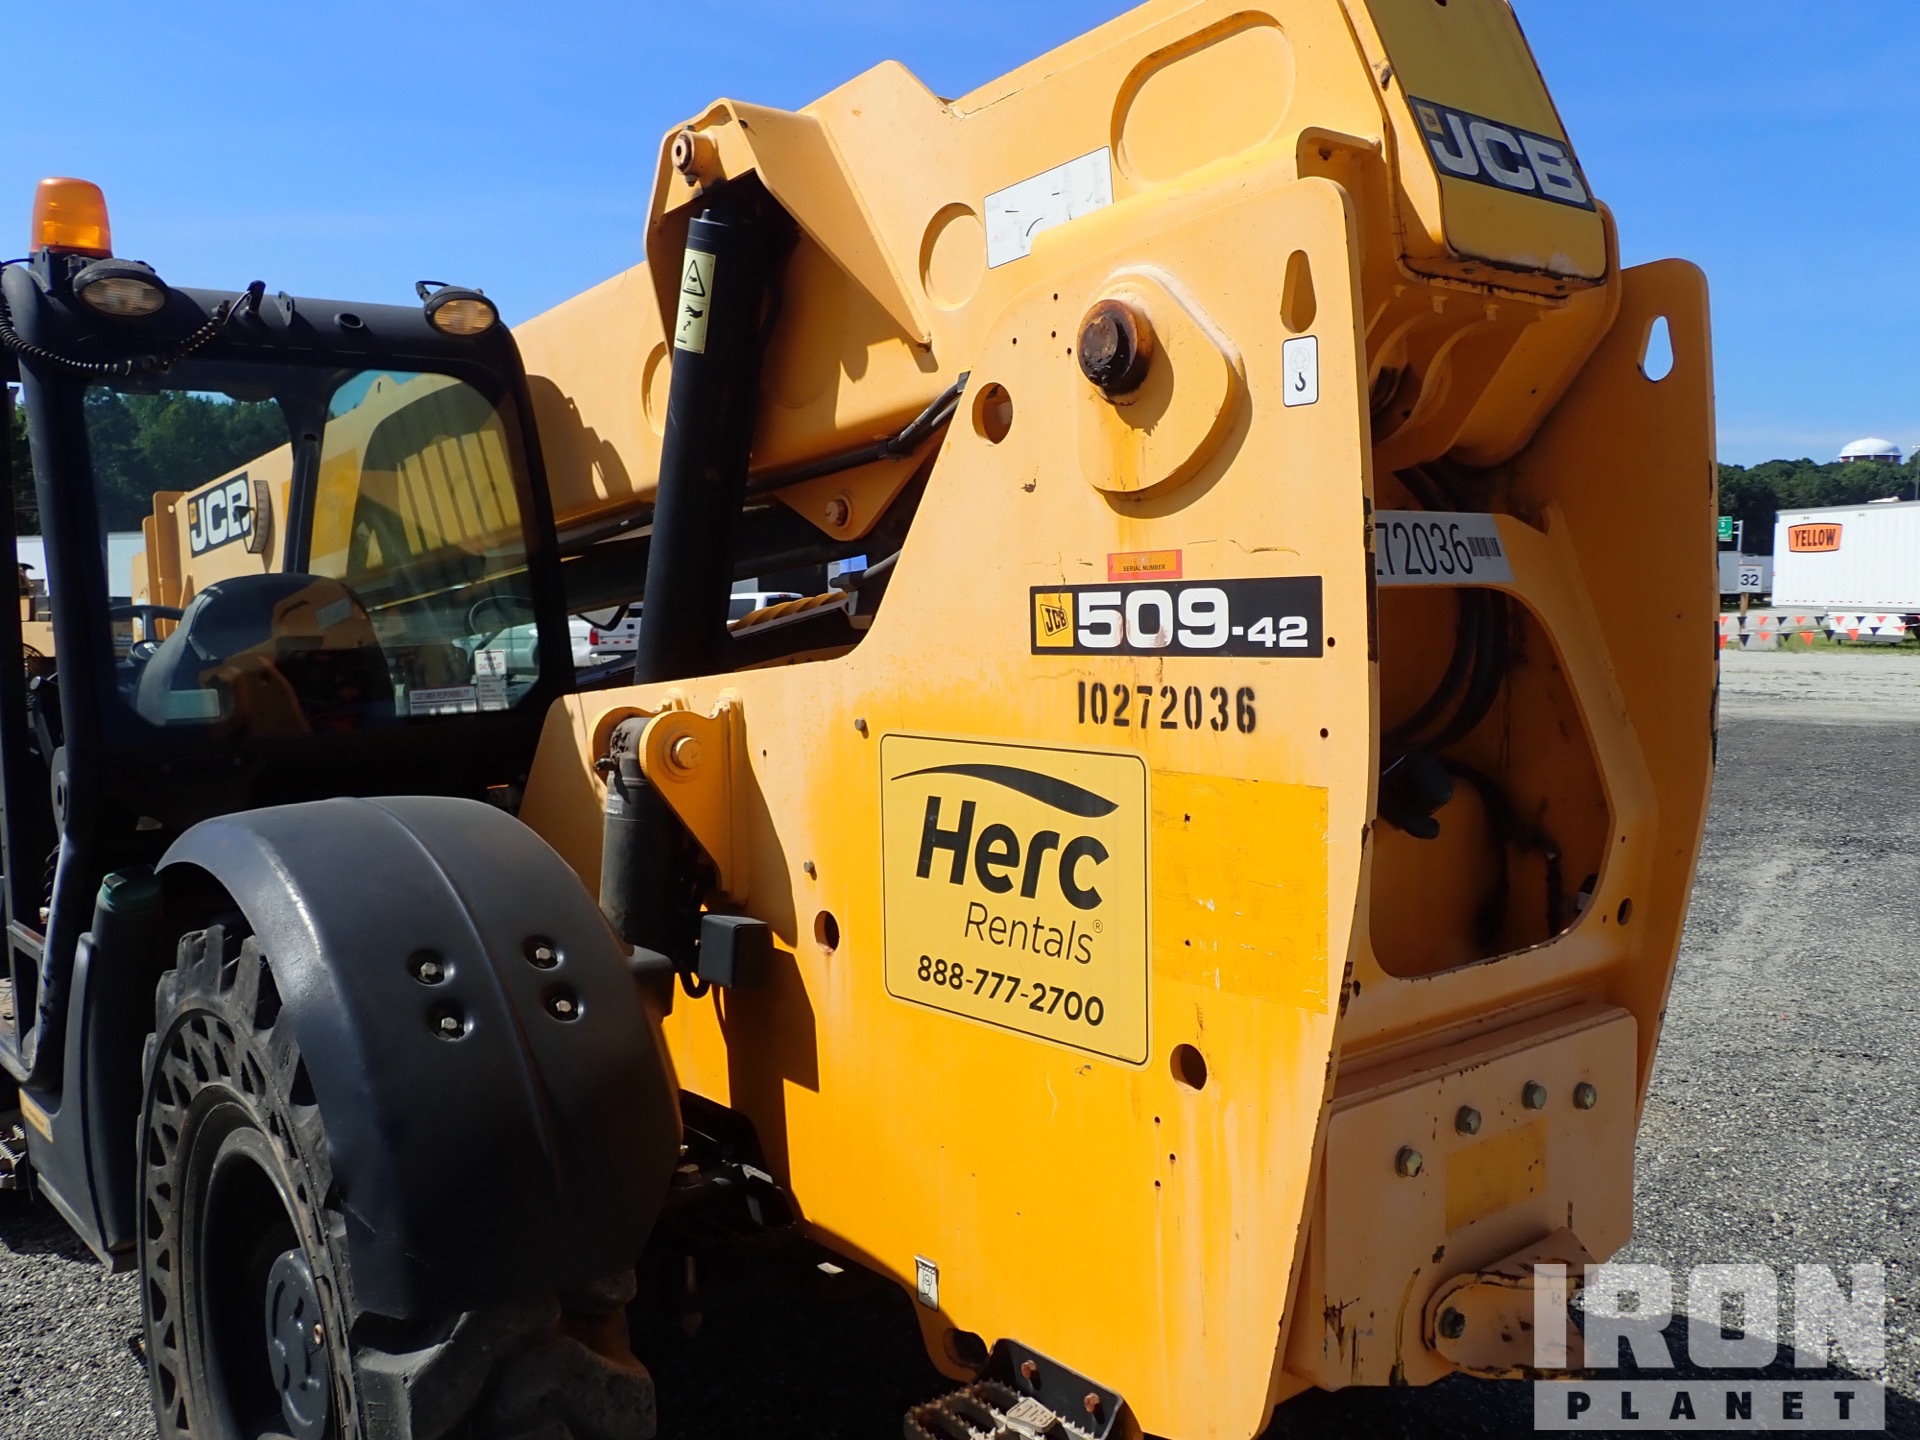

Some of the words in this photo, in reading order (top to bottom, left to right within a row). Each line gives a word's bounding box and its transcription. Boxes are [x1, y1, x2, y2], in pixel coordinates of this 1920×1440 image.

[1430, 113, 1587, 204] JCB
[191, 479, 250, 551] JCB
[1794, 528, 1837, 547] YELLOW
[1376, 522, 1474, 575] 72036
[1740, 573, 1759, 586] 32
[1044, 607, 1068, 633] JCB
[1078, 588, 1309, 648] 509-42
[1078, 681, 1257, 734] 10272036
[915, 795, 1110, 911] Herc
[917, 954, 1104, 1027] 888-777-2700
